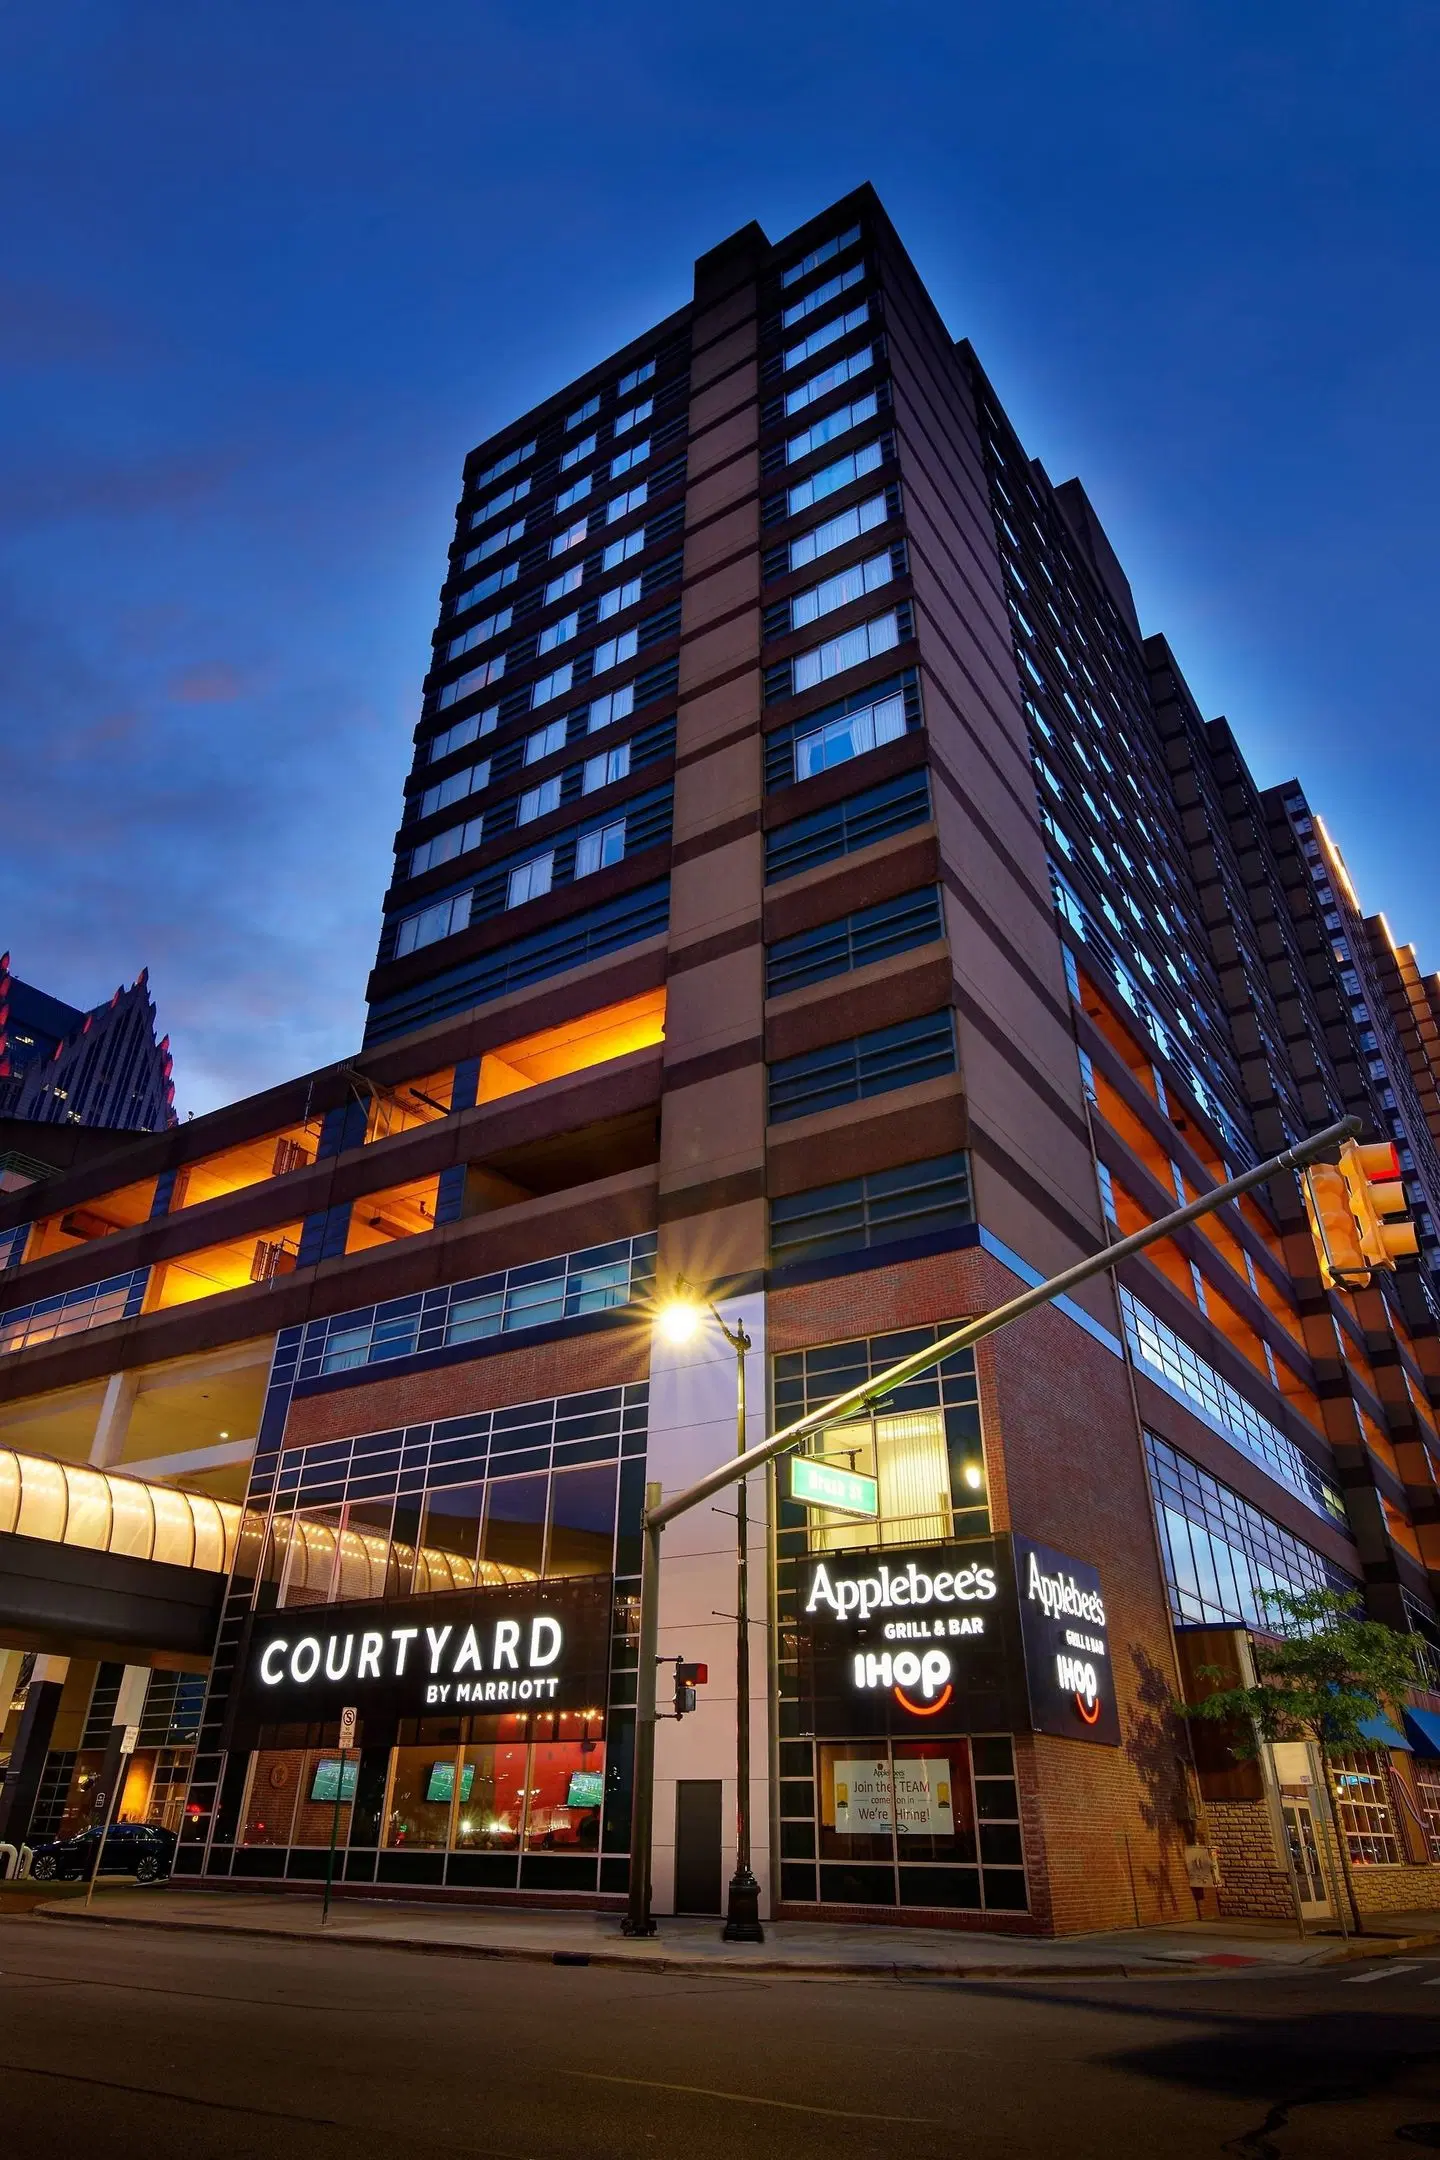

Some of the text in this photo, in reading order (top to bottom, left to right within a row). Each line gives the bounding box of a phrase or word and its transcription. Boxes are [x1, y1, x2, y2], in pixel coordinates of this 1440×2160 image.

[805, 1562, 997, 1620] Applebee's
[1028, 1551, 1106, 1627] Applebee's
[884, 1617, 985, 1640] GRILL & BAR
[260, 1616, 563, 1685] COURTYARD
[1065, 1629, 1085, 1650] GRILL
[1090, 1637, 1105, 1656] BAR
[426, 1678, 559, 1703] BY MARRIOTT
[853, 1781, 873, 1793] Join
[899, 1780, 930, 1793] TEAM
[907, 1795, 915, 1804] in
[858, 1808, 930, 1822] We're Hiring!
